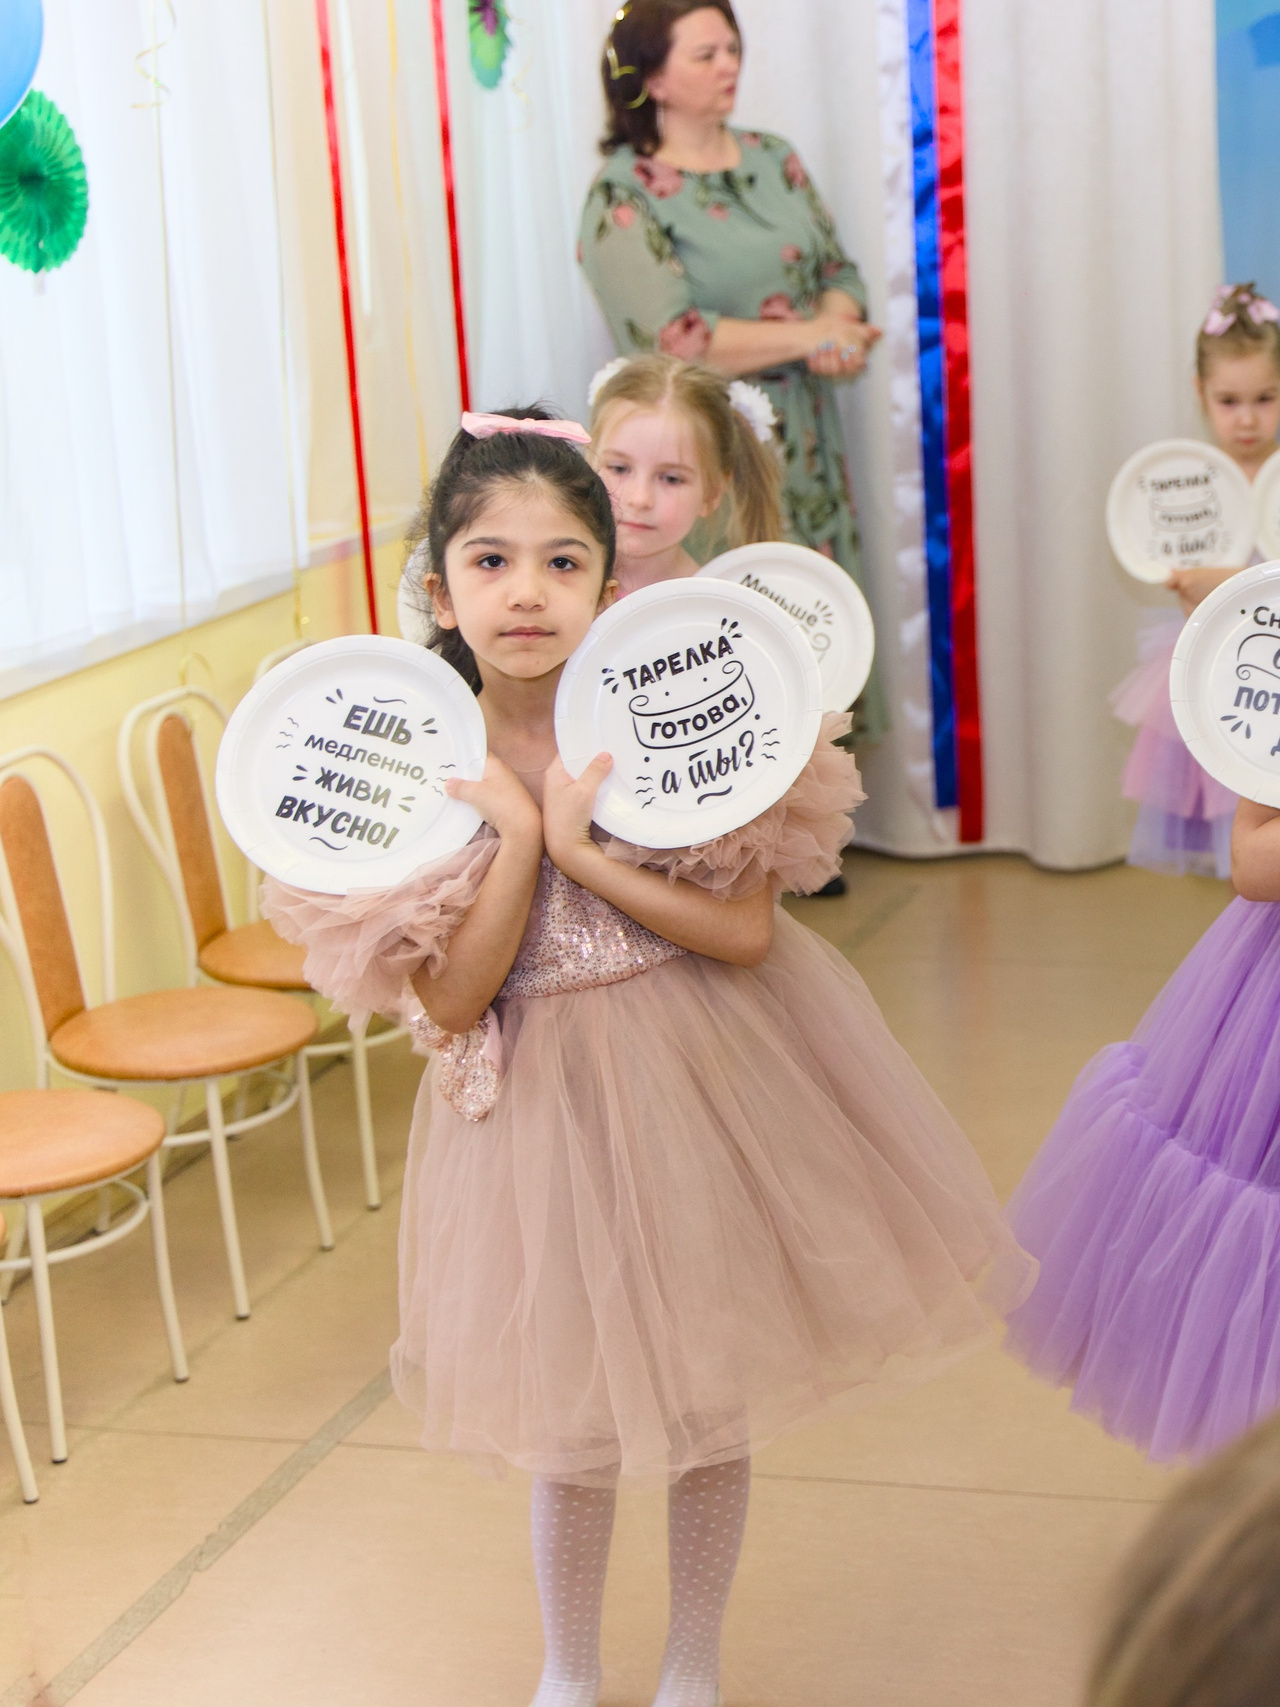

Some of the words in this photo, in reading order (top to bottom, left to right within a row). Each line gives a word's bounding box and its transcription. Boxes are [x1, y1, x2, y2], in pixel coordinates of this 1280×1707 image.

[622, 635, 734, 691] ТАРЕЛКА
[343, 704, 413, 746] ЕШЬ
[650, 694, 748, 739] готова,
[304, 734, 428, 785] медленно,
[661, 769, 682, 794] а
[275, 795, 400, 849] ВКУСНО!
